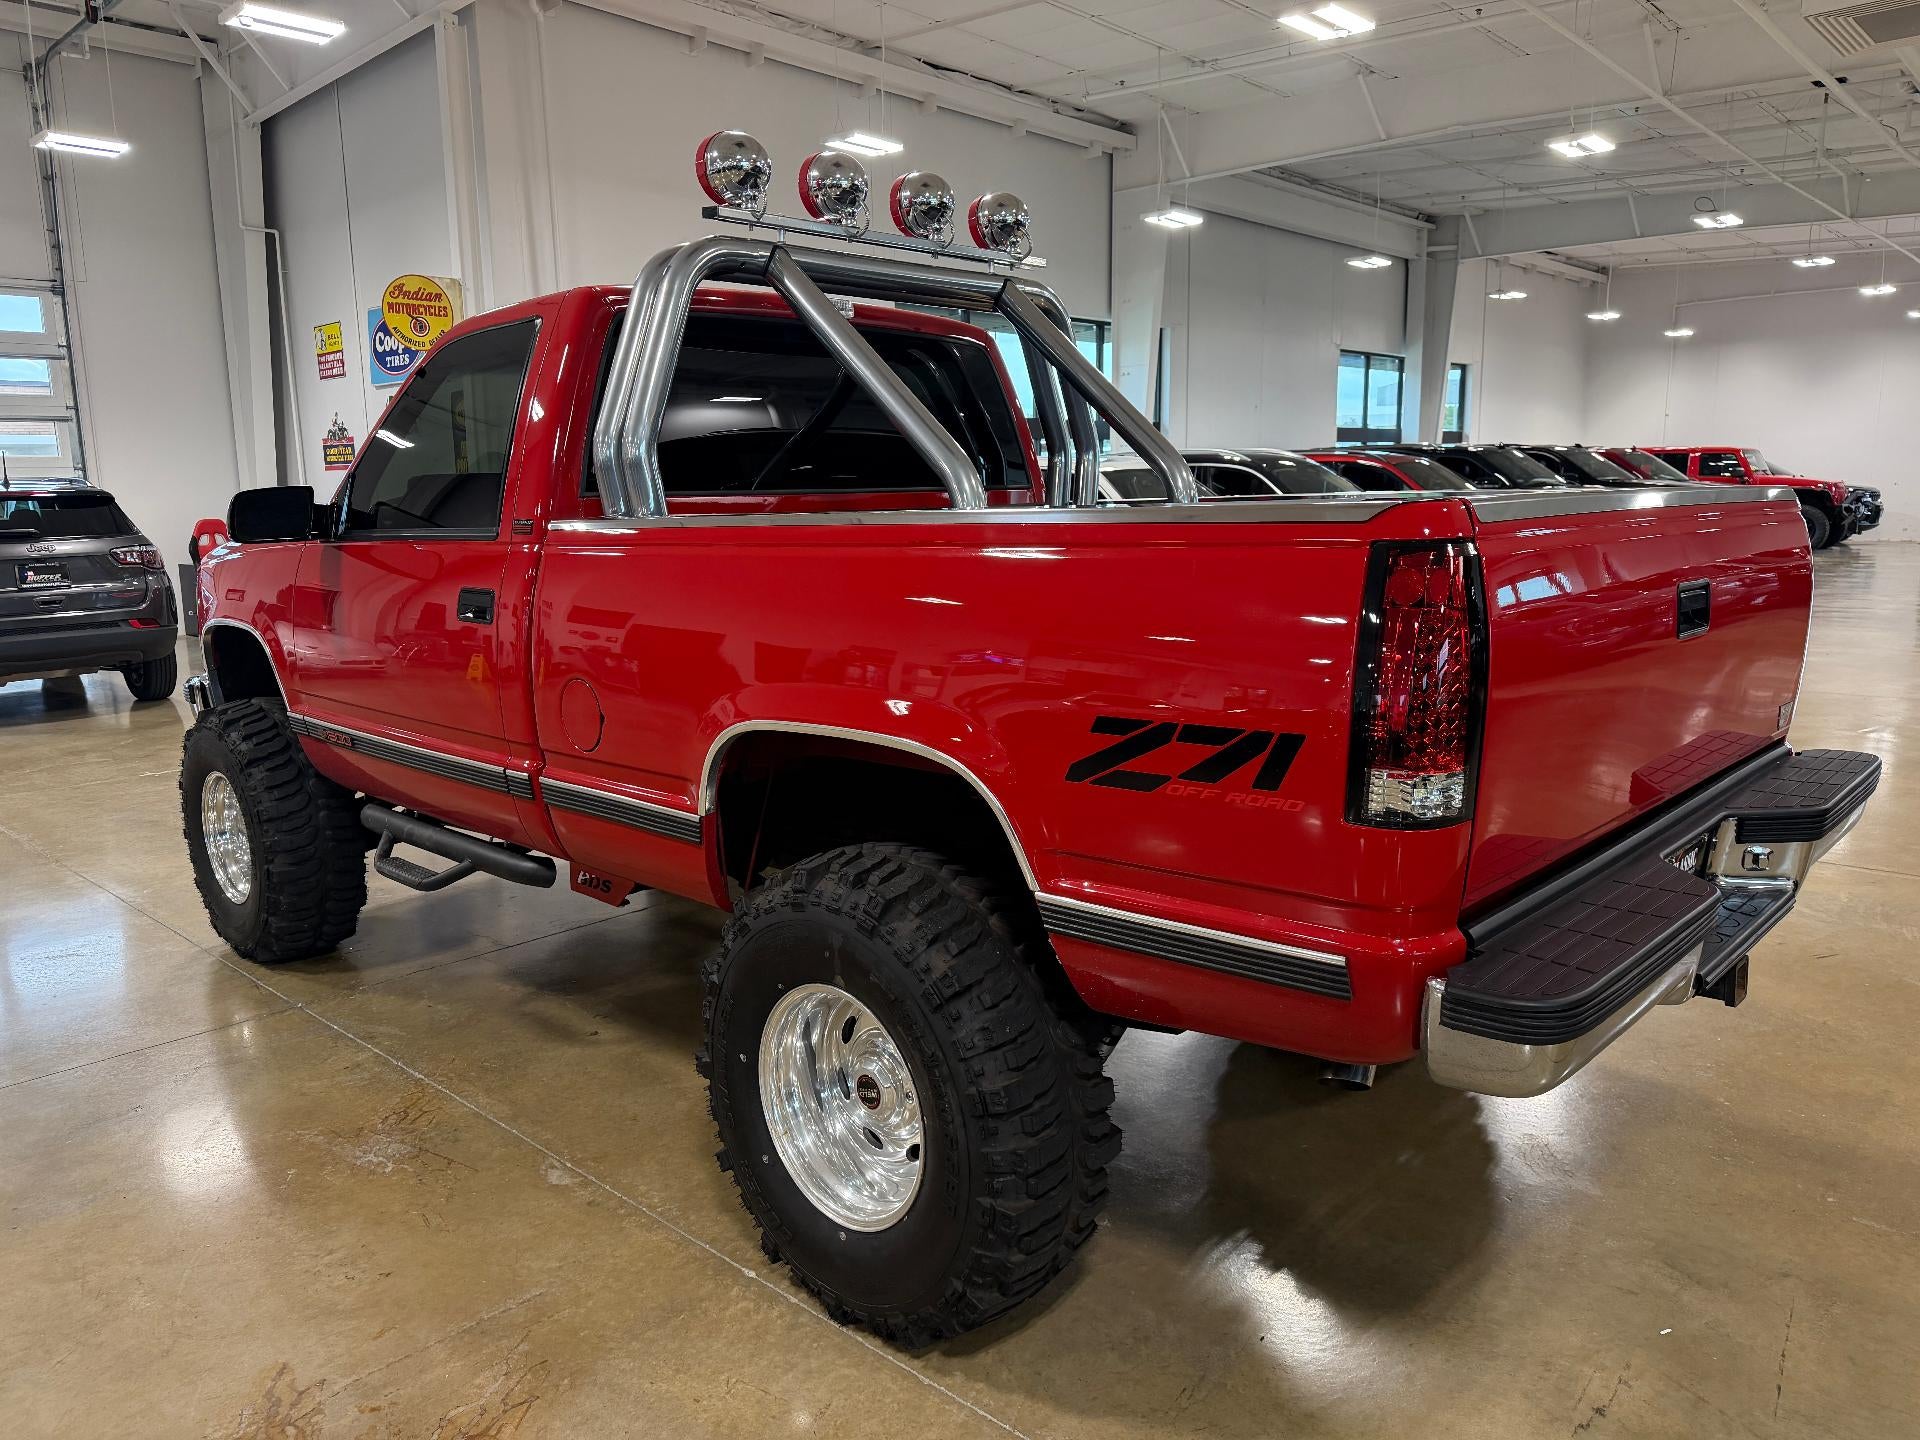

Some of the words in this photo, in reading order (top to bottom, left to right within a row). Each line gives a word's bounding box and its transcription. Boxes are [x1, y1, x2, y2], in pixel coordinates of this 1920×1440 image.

[389, 282, 443, 303] Indian
[386, 301, 449, 318] MOTORCYCLES
[375, 331, 416, 354] Coop
[392, 326, 426, 348] AUTHORIZED
[429, 329, 447, 346] DEALER
[385, 354, 410, 368] TIRES
[25, 544, 56, 553] Jeep
[1064, 715, 1307, 793] Z71
[1165, 784, 1222, 799] OFF
[1224, 792, 1305, 812] ROAD
[859, 1090, 878, 1098] WELD
